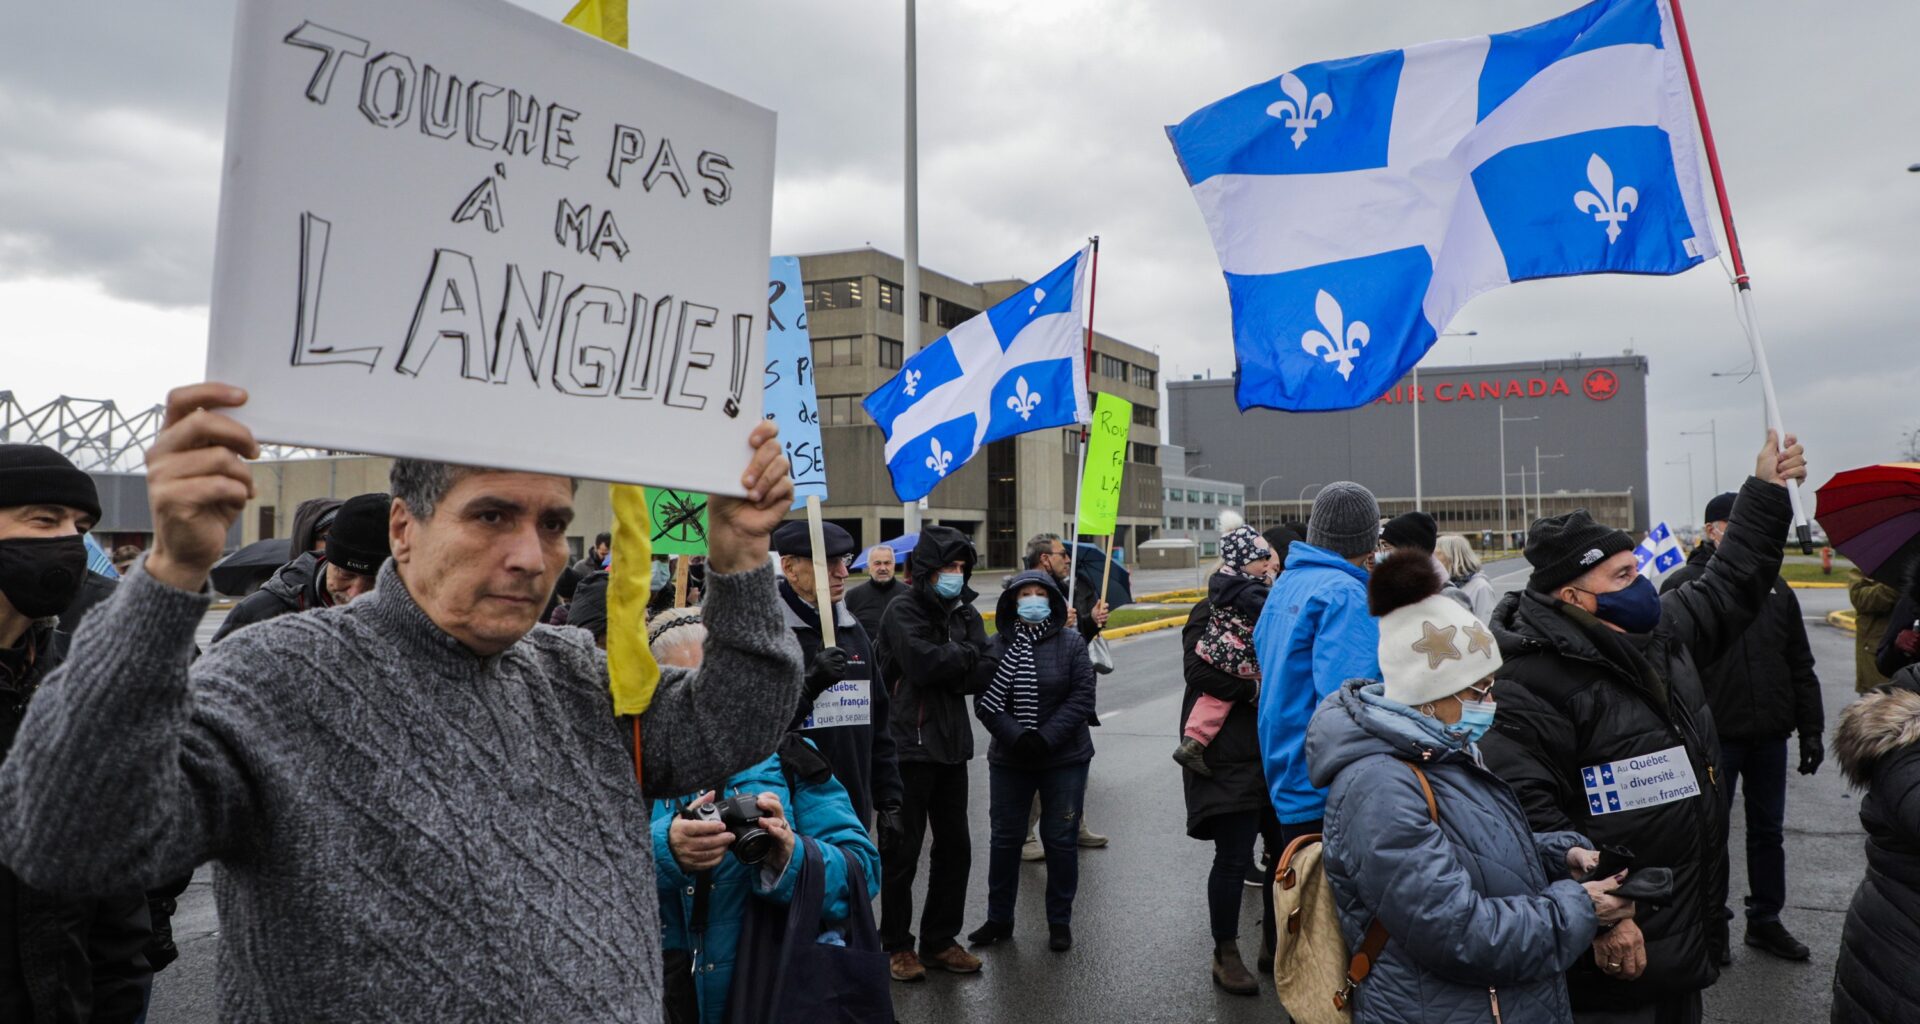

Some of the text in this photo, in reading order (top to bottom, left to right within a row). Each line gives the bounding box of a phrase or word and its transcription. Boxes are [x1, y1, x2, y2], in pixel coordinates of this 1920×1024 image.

[284, 20, 734, 206] TOUCHE PAS
[452, 162, 630, 262] À MA
[291, 211, 754, 418] LANGUE!
[1374, 377, 1570, 404] AIR CANADA
[840, 697, 869, 708] français
[817, 716, 834, 725] que
[1617, 765, 1629, 774] Au
[1620, 781, 1628, 790] la
[1624, 799, 1635, 807] se
[1635, 795, 1648, 806] vit
[1648, 795, 1659, 803] en
